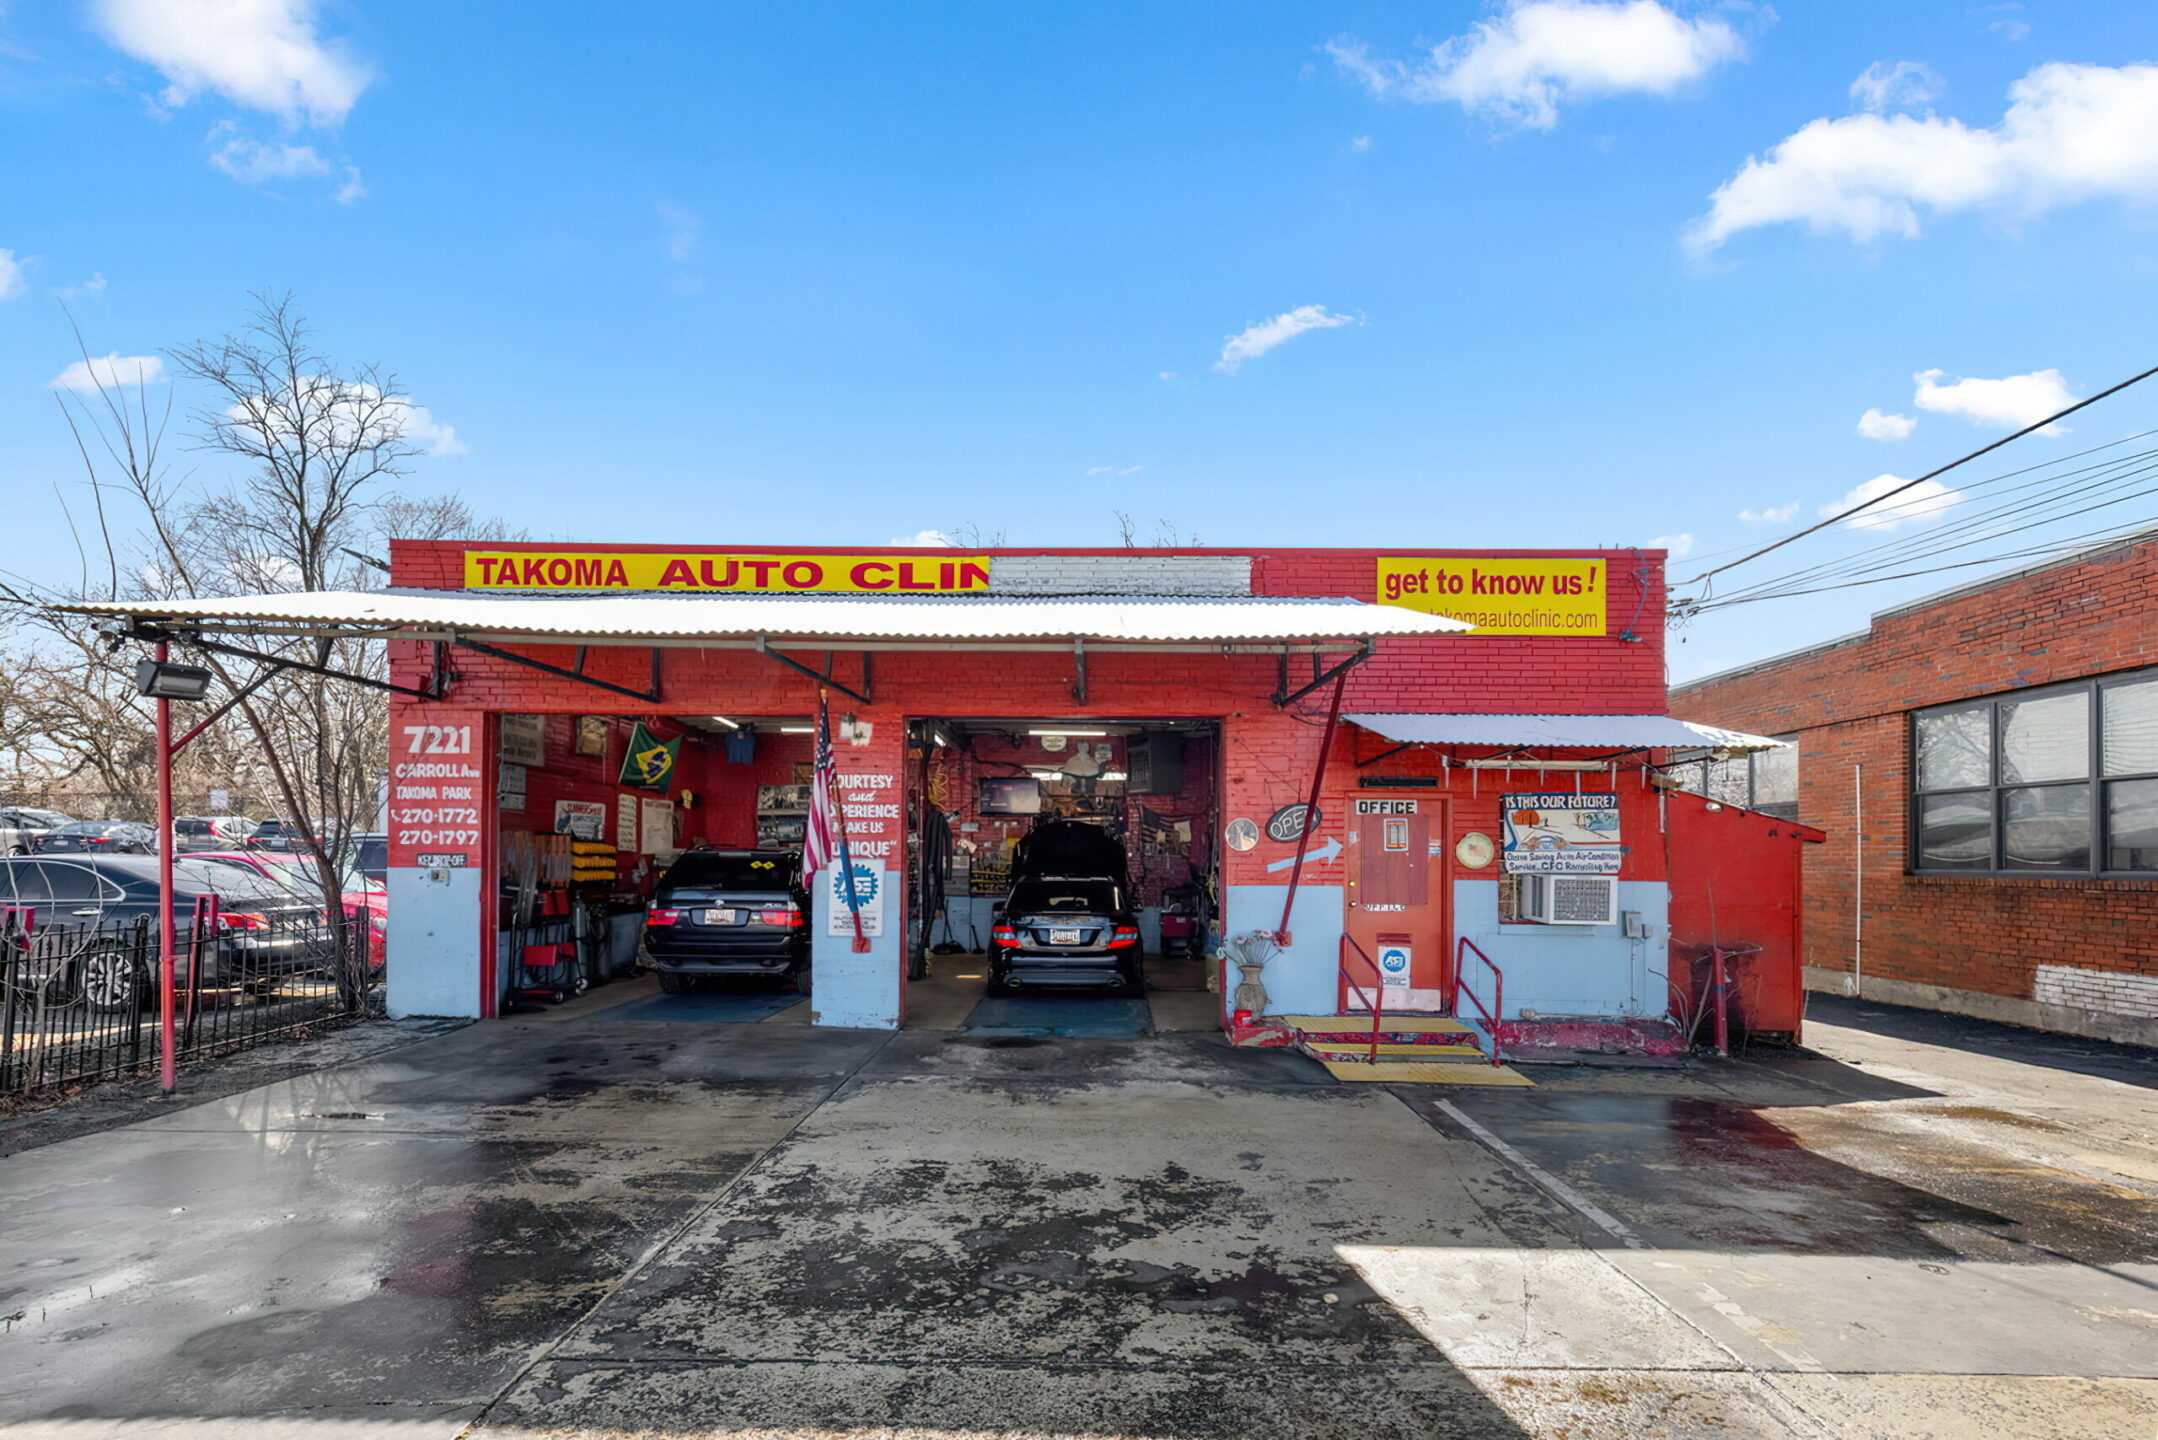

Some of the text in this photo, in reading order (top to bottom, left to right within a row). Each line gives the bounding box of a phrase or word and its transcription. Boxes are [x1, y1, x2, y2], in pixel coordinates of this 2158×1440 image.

[476, 558, 989, 590] TAKOMA AUTO CLIN
[1385, 568, 1429, 600] get
[1436, 568, 1464, 595] to
[1472, 568, 1545, 595] know
[403, 725, 471, 754] 7221
[395, 763, 459, 778] CARROLL
[834, 774, 894, 789] OURTESY
[396, 786, 472, 800] TAKOMA PARK
[848, 790, 877, 802] and
[1358, 801, 1415, 814] OFFICE
[1505, 795, 1616, 809] IS THIS OUR FUTURE?
[401, 808, 479, 824] 270-1772
[829, 804, 900, 819] XPERIENCE
[870, 822, 885, 834] US
[399, 830, 479, 845] 270-1797
[1541, 862, 1563, 871] CFC
